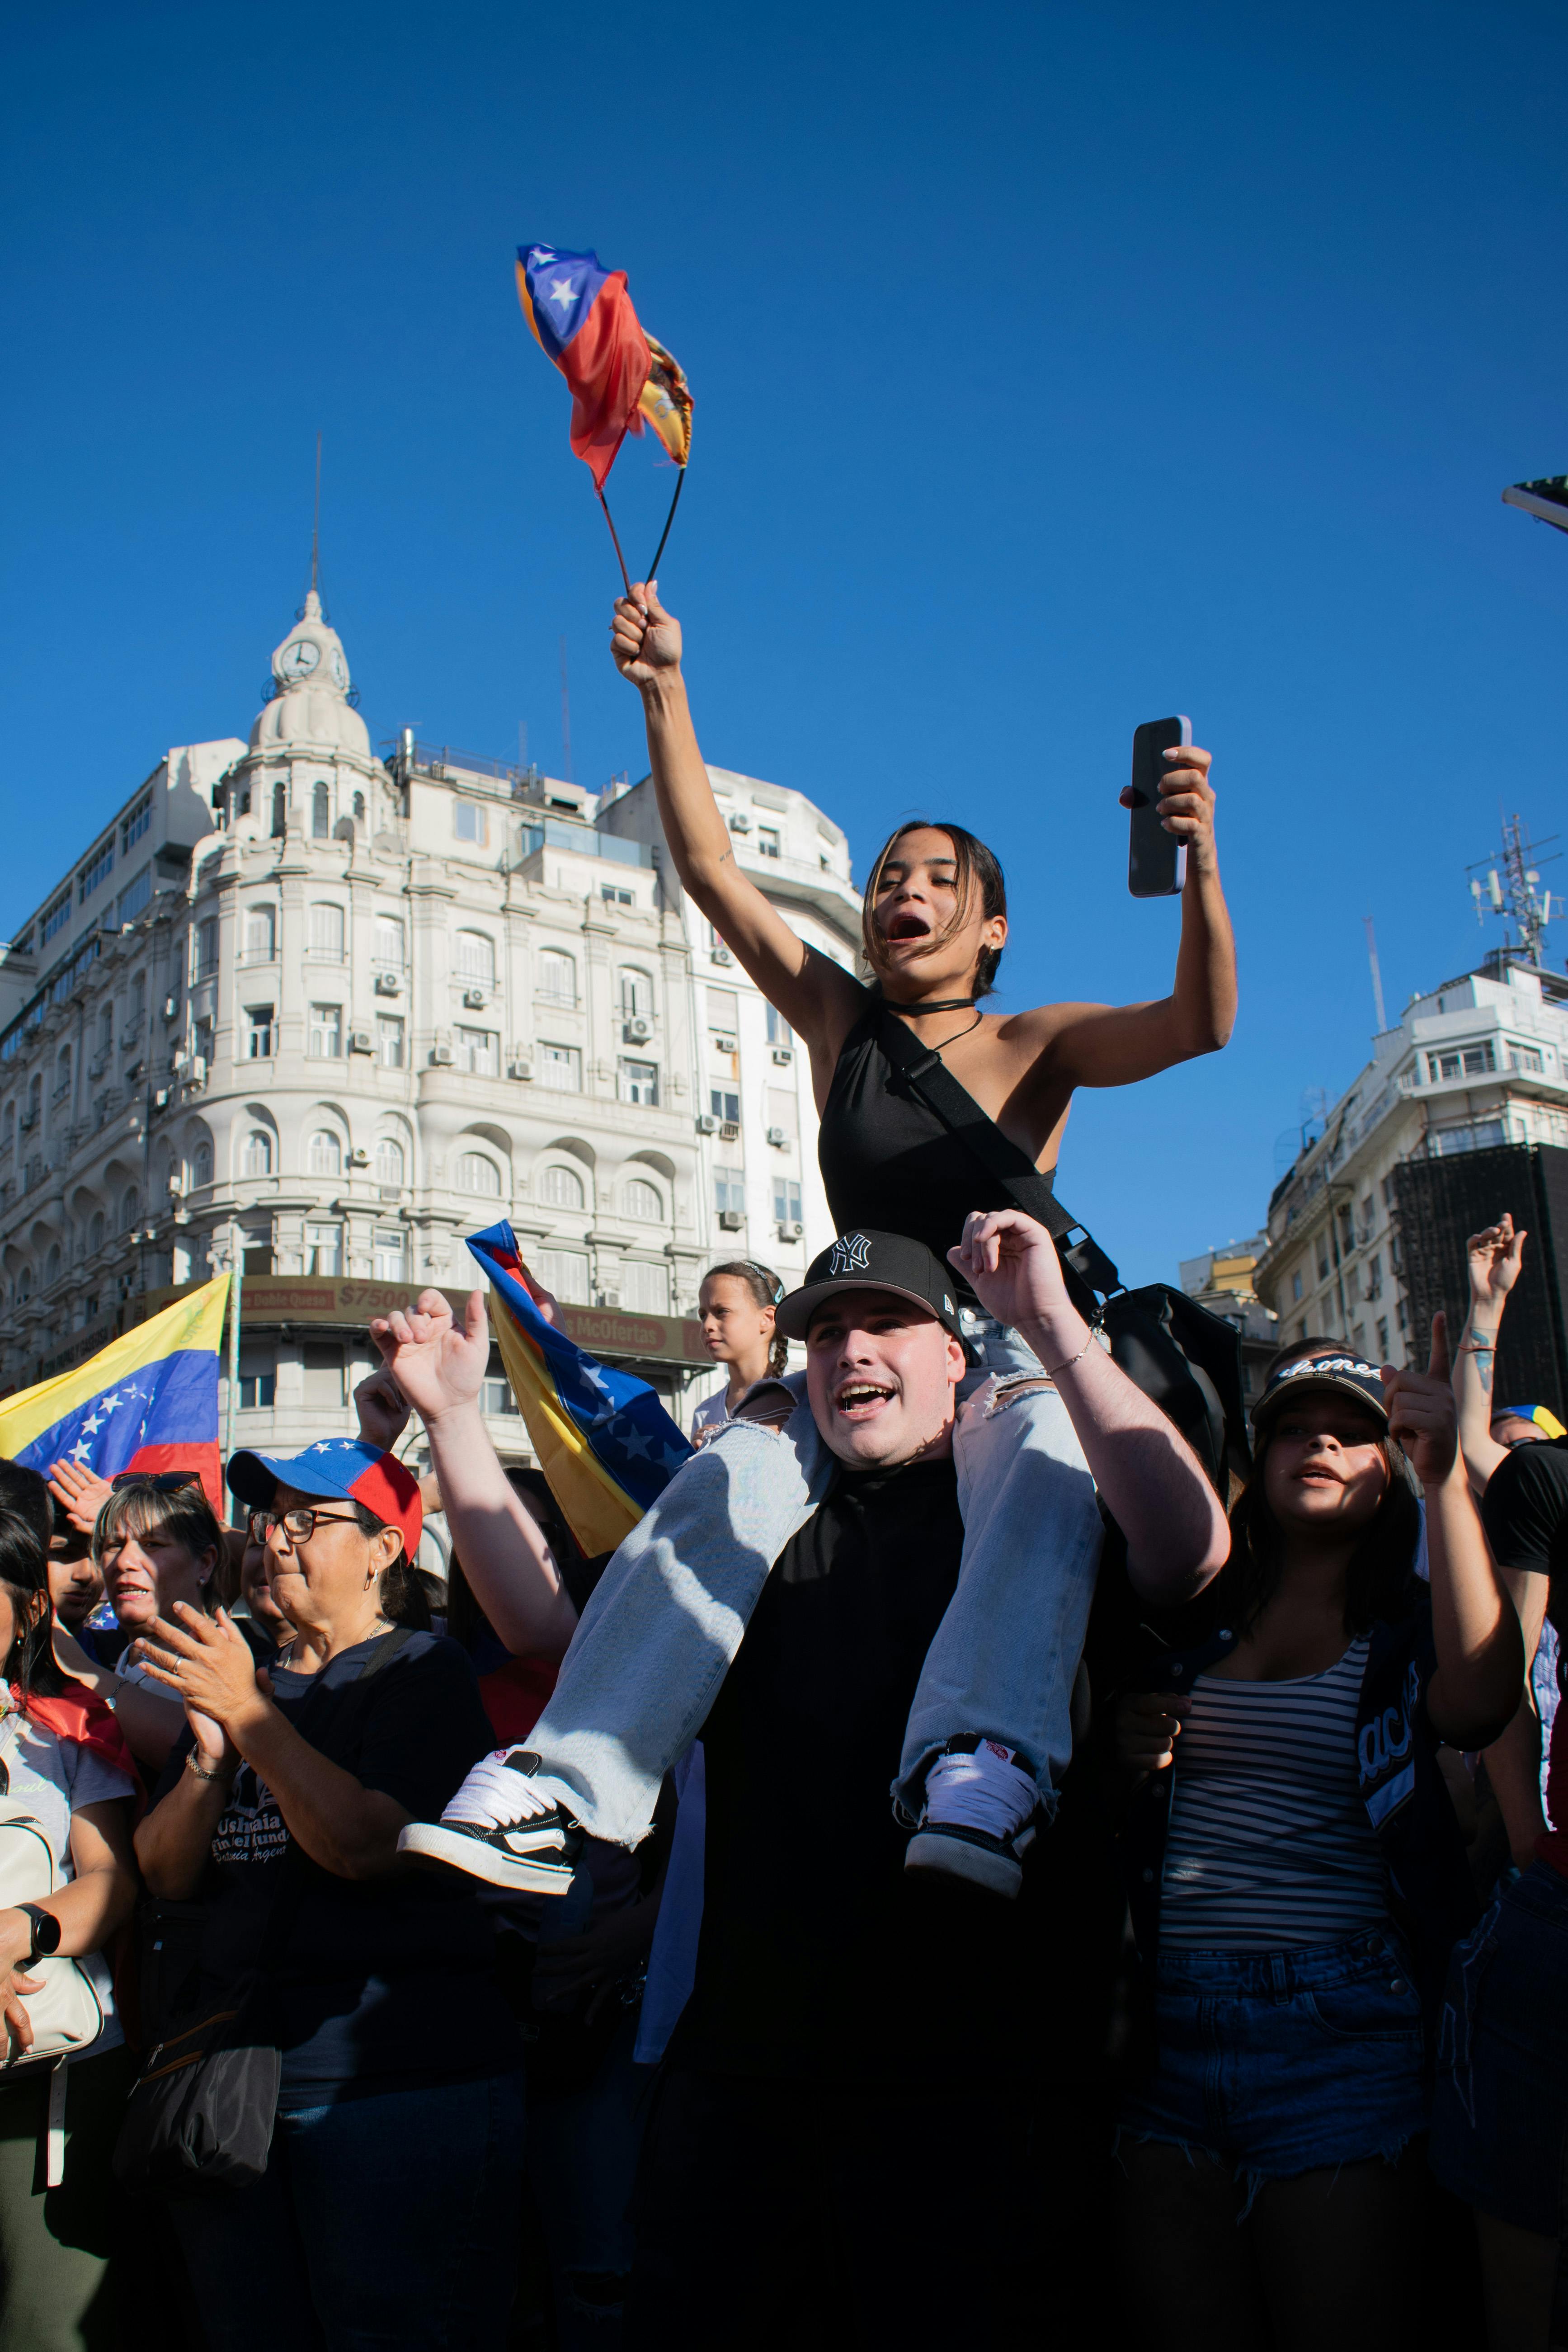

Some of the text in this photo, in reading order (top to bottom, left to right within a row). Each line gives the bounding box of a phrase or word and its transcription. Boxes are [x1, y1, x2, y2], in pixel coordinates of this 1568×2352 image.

[829, 1234, 872, 1275] NY
[339, 1284, 410, 1310] $7500
[577, 1316, 658, 1345] McOfertas
